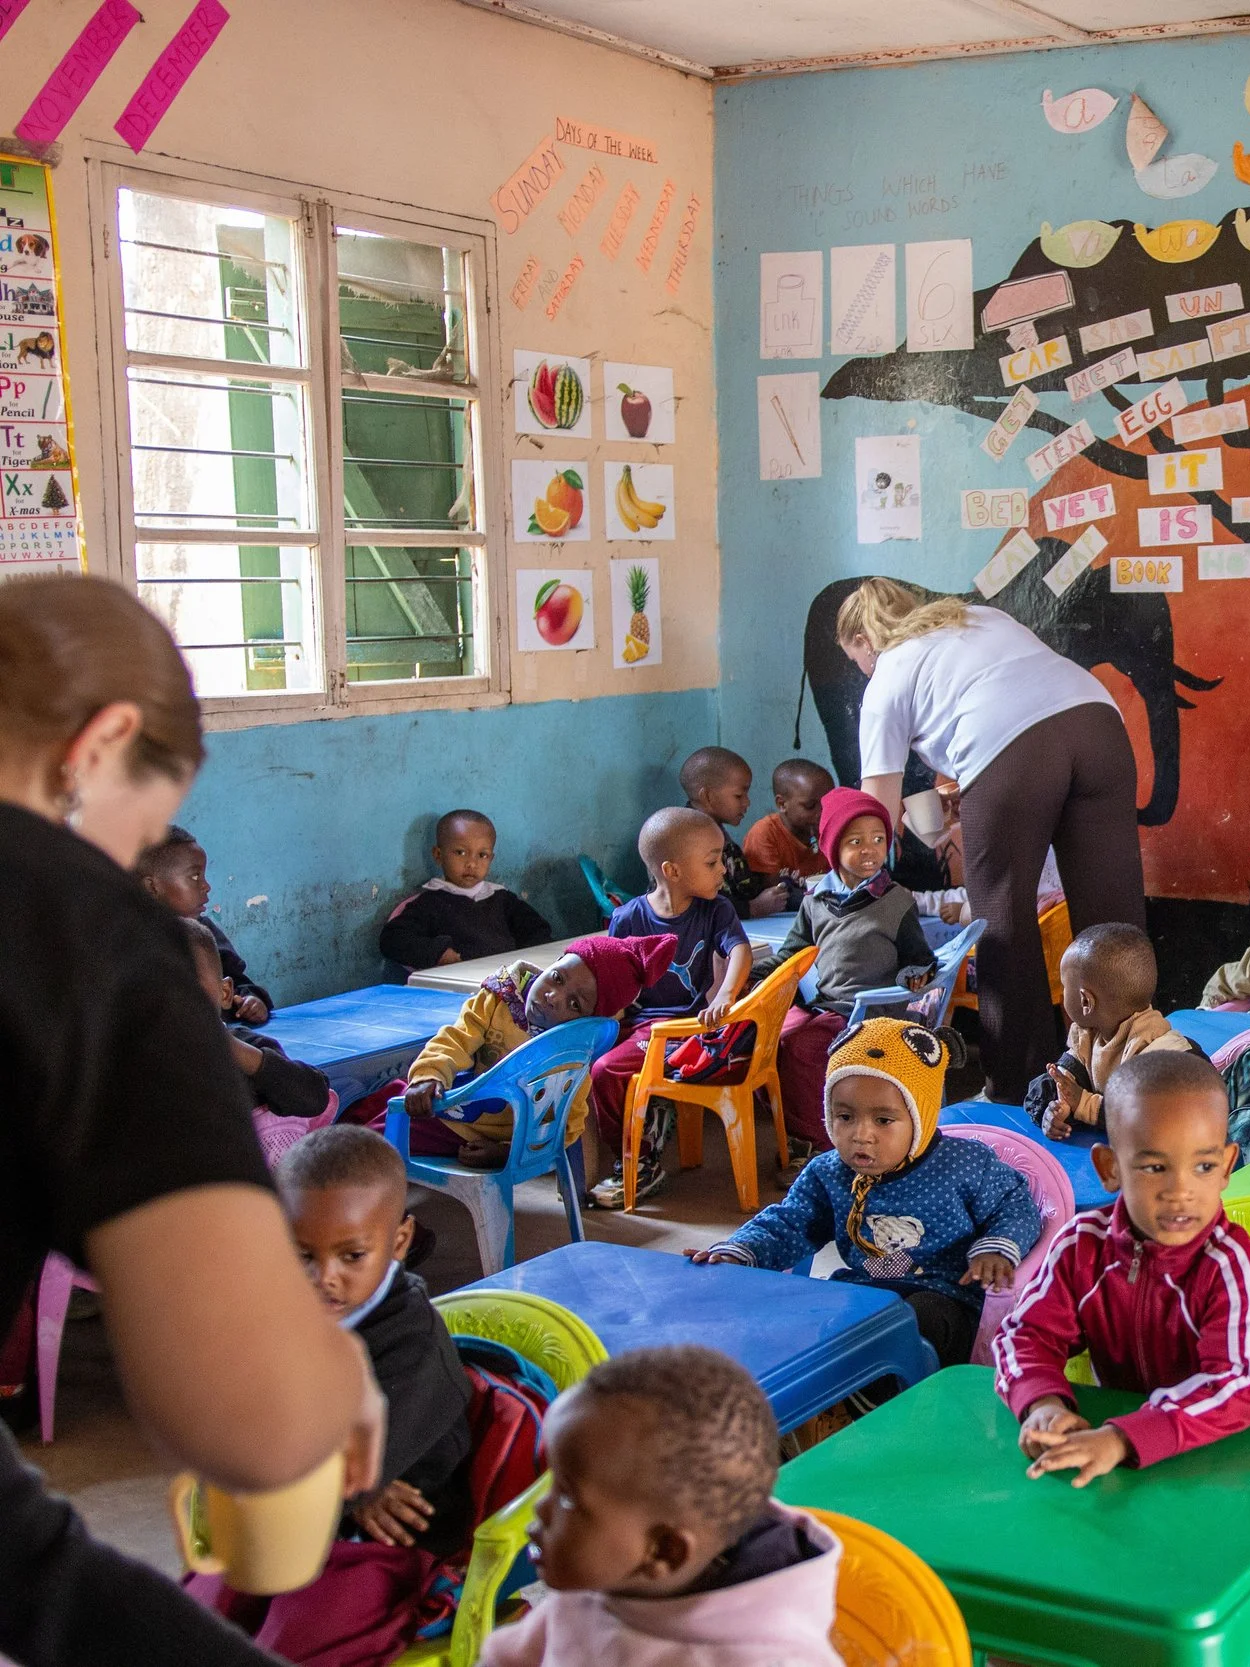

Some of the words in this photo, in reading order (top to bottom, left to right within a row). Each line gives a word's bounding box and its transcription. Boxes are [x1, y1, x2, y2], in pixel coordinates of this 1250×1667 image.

[22, 1, 130, 138] NOVEMBER
[124, 7, 220, 136] DECEMBER
[556, 117, 581, 144] DAYS
[588, 133, 597, 148] OF
[605, 136, 622, 156] THE
[629, 143, 654, 162] WEEK
[497, 145, 564, 234] SUNDAY
[559, 164, 604, 234] MONDAY
[601, 190, 641, 257] TUESDAY
[637, 181, 674, 269] WEDNESDAY
[668, 197, 701, 289] THURSDAY
[514, 257, 538, 306] FRIDAY
[546, 257, 584, 320] SATURDAY
[1179, 291, 1222, 317] UN
[1008, 341, 1065, 381] CAR
[1072, 354, 1127, 398] NET
[1148, 341, 1202, 378] SAT
[1, 406, 35, 418] Pencil
[987, 390, 1031, 456] GET
[1120, 392, 1172, 435] EGG
[0, 425, 25, 448] Tt
[1034, 425, 1087, 471] TEN
[2, 455, 32, 468] Tiger
[5, 473, 33, 496] Xx
[9, 506, 41, 516] X-mas
[19, 522, 26, 530] C
[31, 522, 38, 530] D
[43, 522, 49, 530] E
[54, 521, 60, 529] F
[65, 521, 73, 529] G
[966, 491, 1027, 527] BED
[1049, 488, 1109, 528] YET
[10, 542, 16, 550] P
[33, 541, 41, 549] R
[20, 532, 25, 540] J
[36, 551, 42, 559] X
[58, 550, 64, 558] Z
[1116, 559, 1172, 585] BOOK
